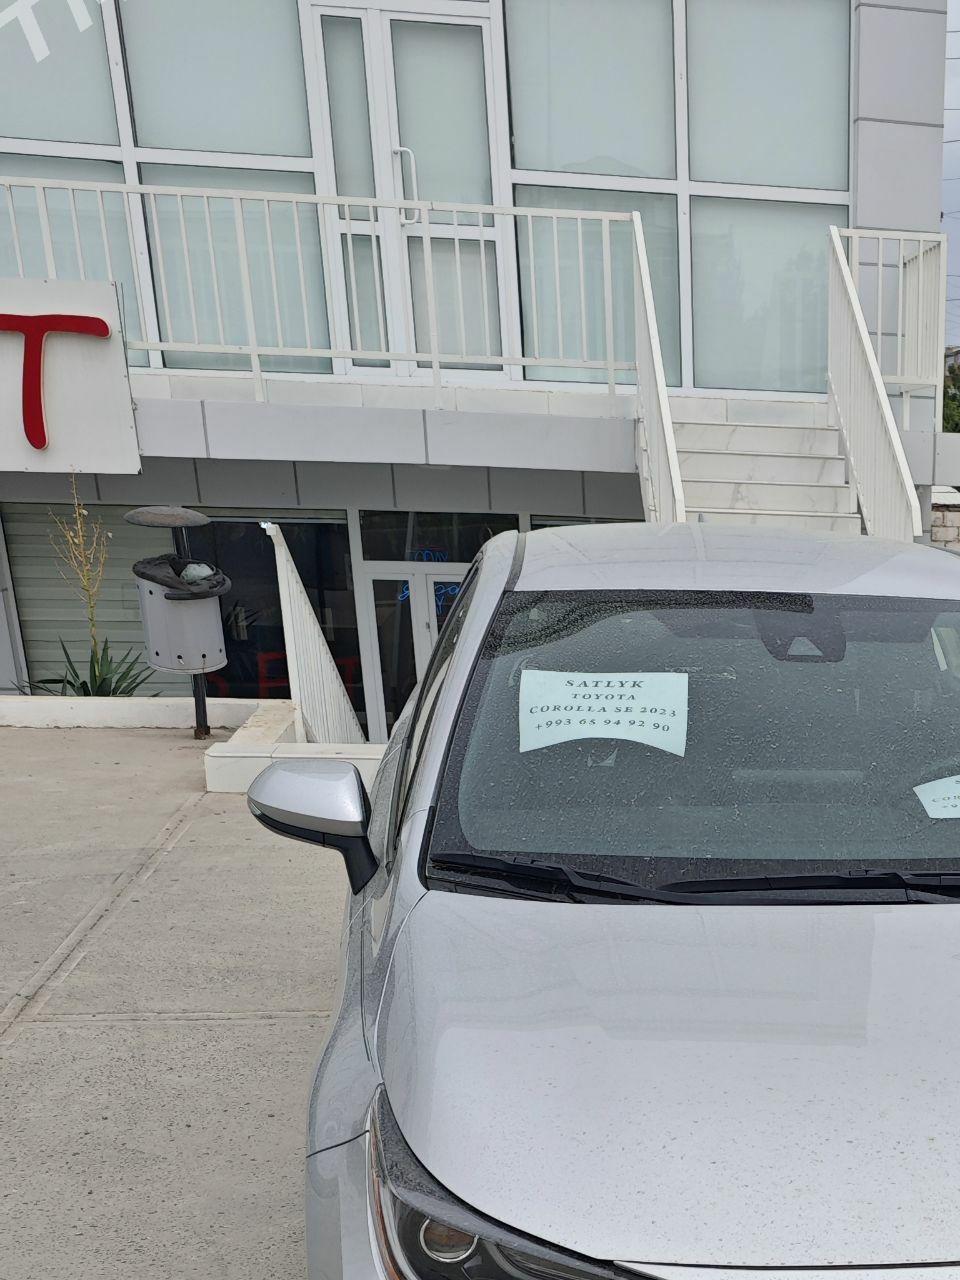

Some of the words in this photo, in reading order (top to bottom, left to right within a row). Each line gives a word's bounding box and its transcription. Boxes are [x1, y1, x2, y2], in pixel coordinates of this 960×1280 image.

[564, 679, 645, 689] SATLYK
[571, 693, 636, 701] TOYOTA
[529, 705, 607, 715] COROLLA
[639, 706, 677, 718] 2023
[535, 718, 572, 731] +993
[578, 718, 596, 726] 65
[628, 719, 645, 728] 92
[652, 722, 670, 732] 90
